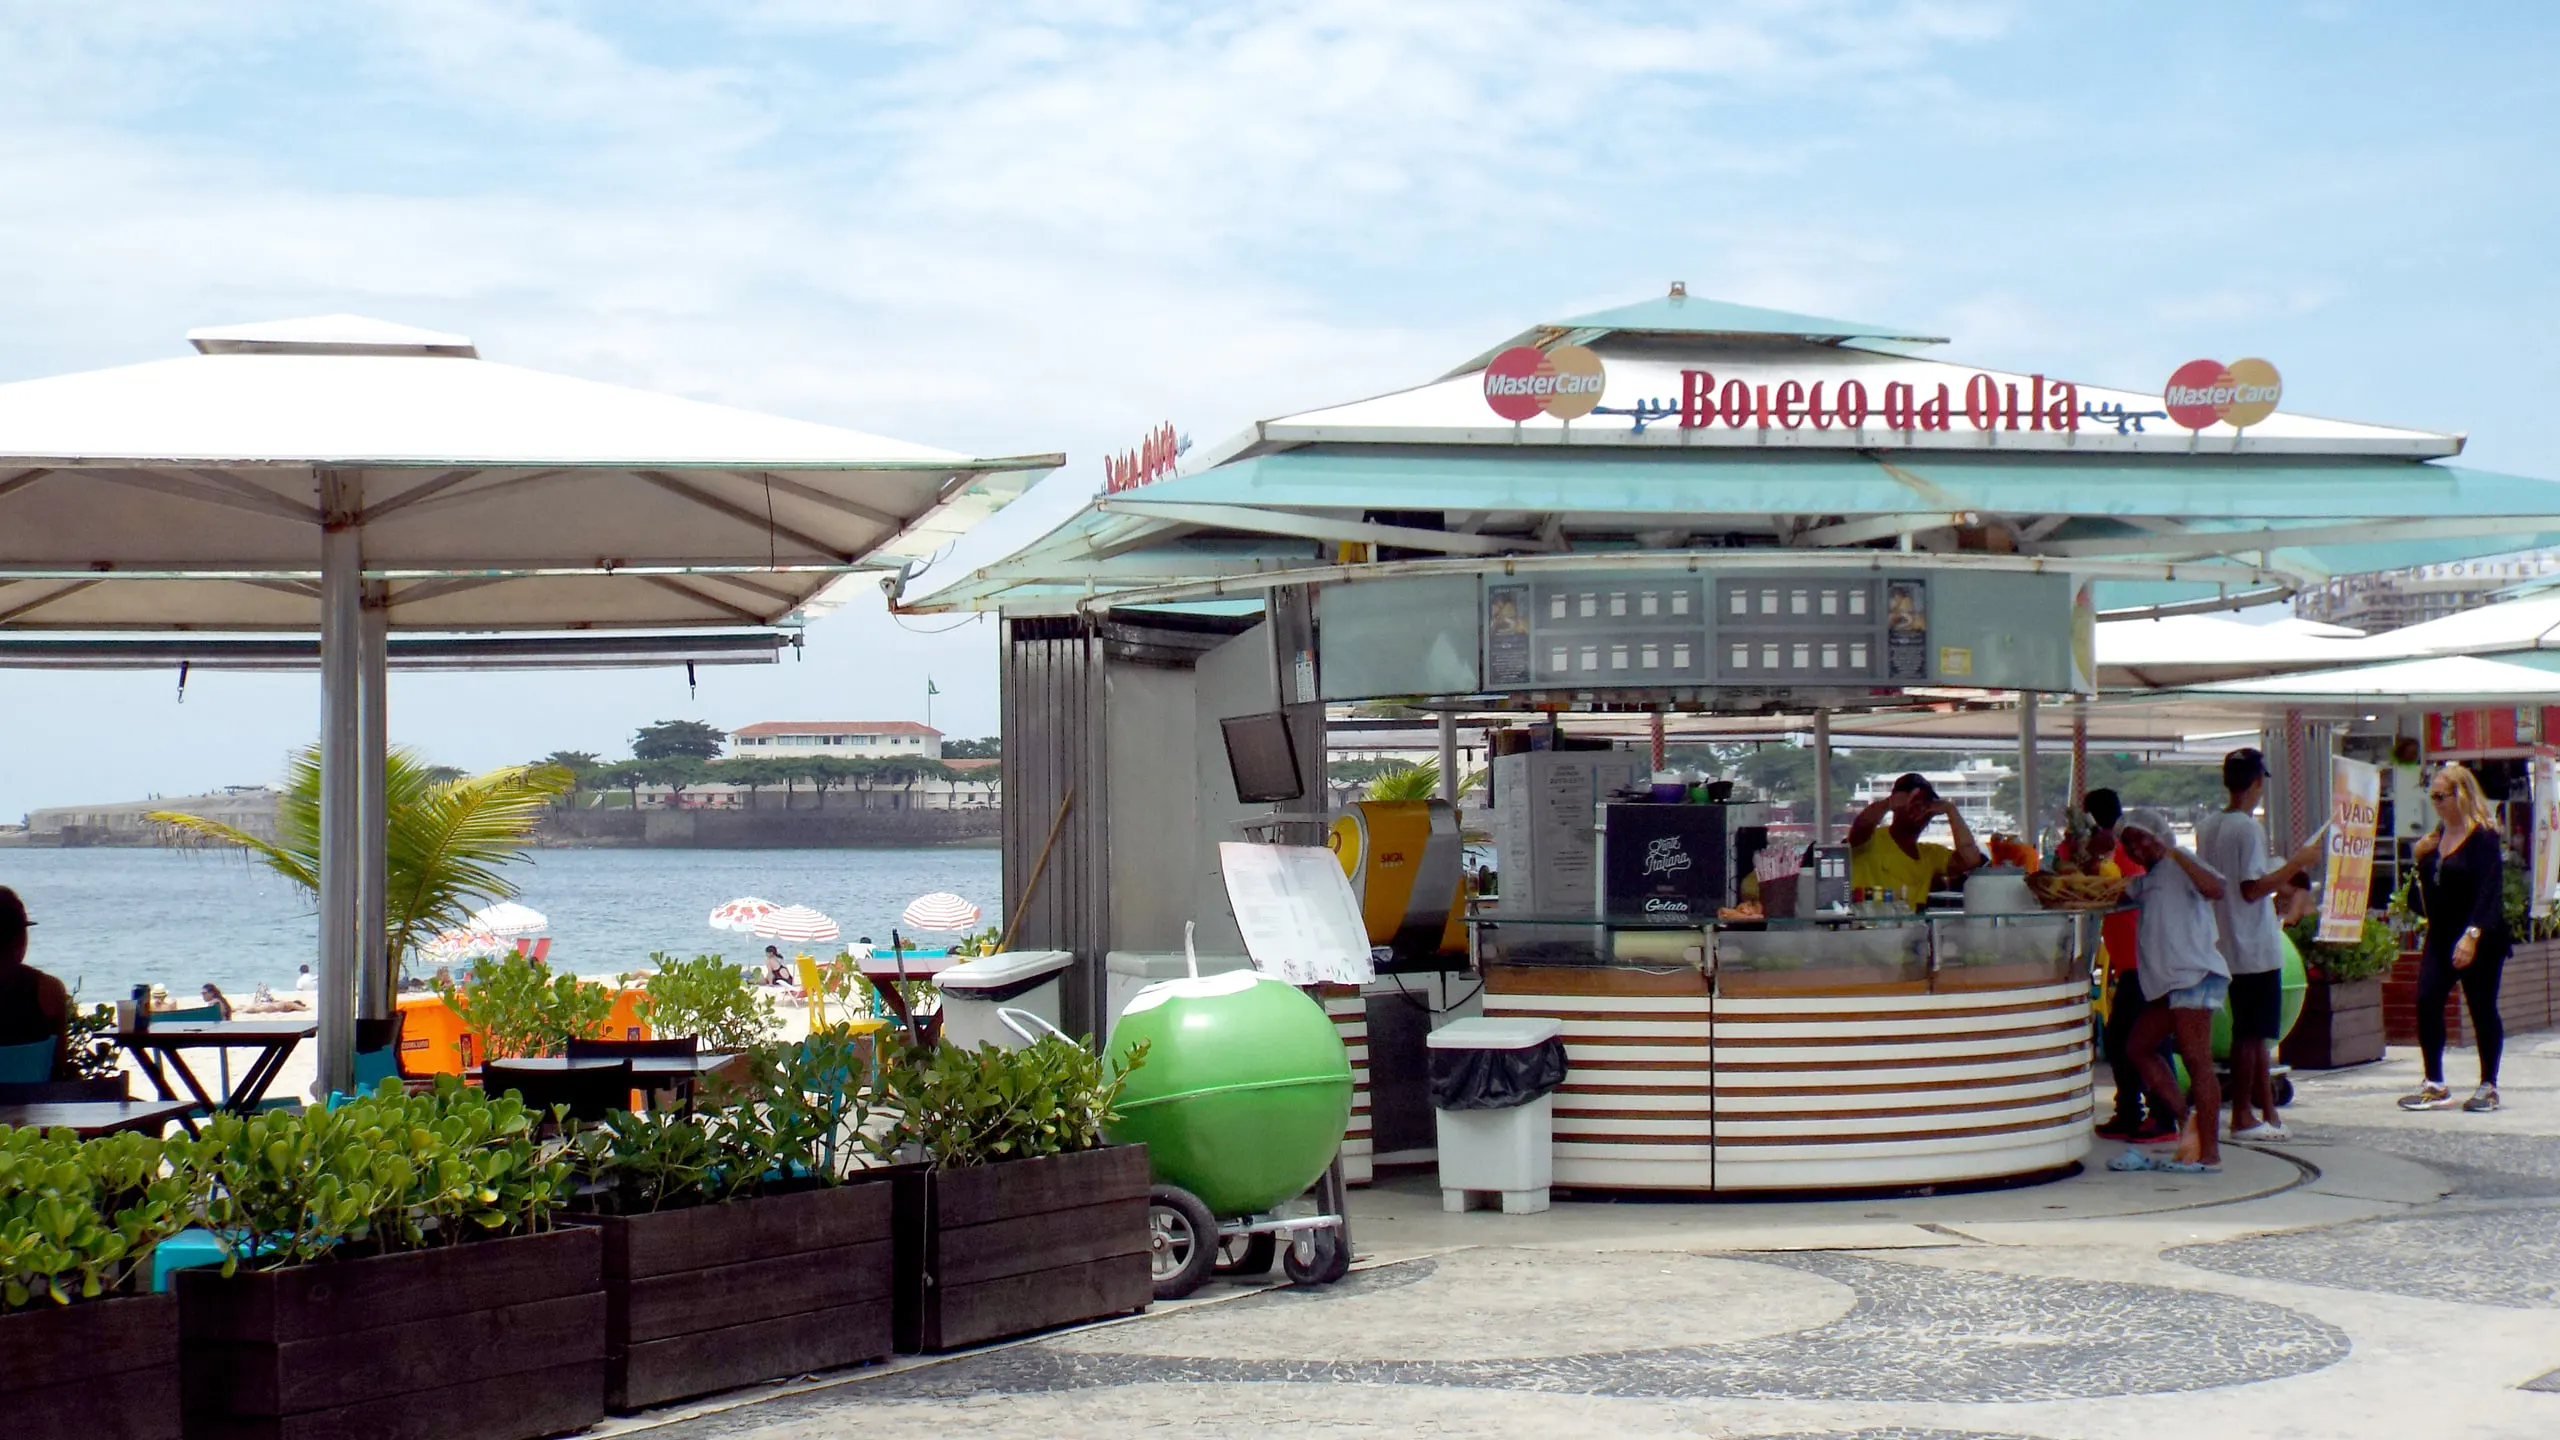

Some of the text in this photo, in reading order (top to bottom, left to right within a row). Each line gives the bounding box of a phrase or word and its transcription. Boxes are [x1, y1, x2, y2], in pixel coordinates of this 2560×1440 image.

[1486, 372, 1603, 396] MasterCard
[2166, 382, 2281, 406] MasterCard
[2432, 561, 2550, 577] SOFITEL
[1645, 898, 1688, 912] Gelato
